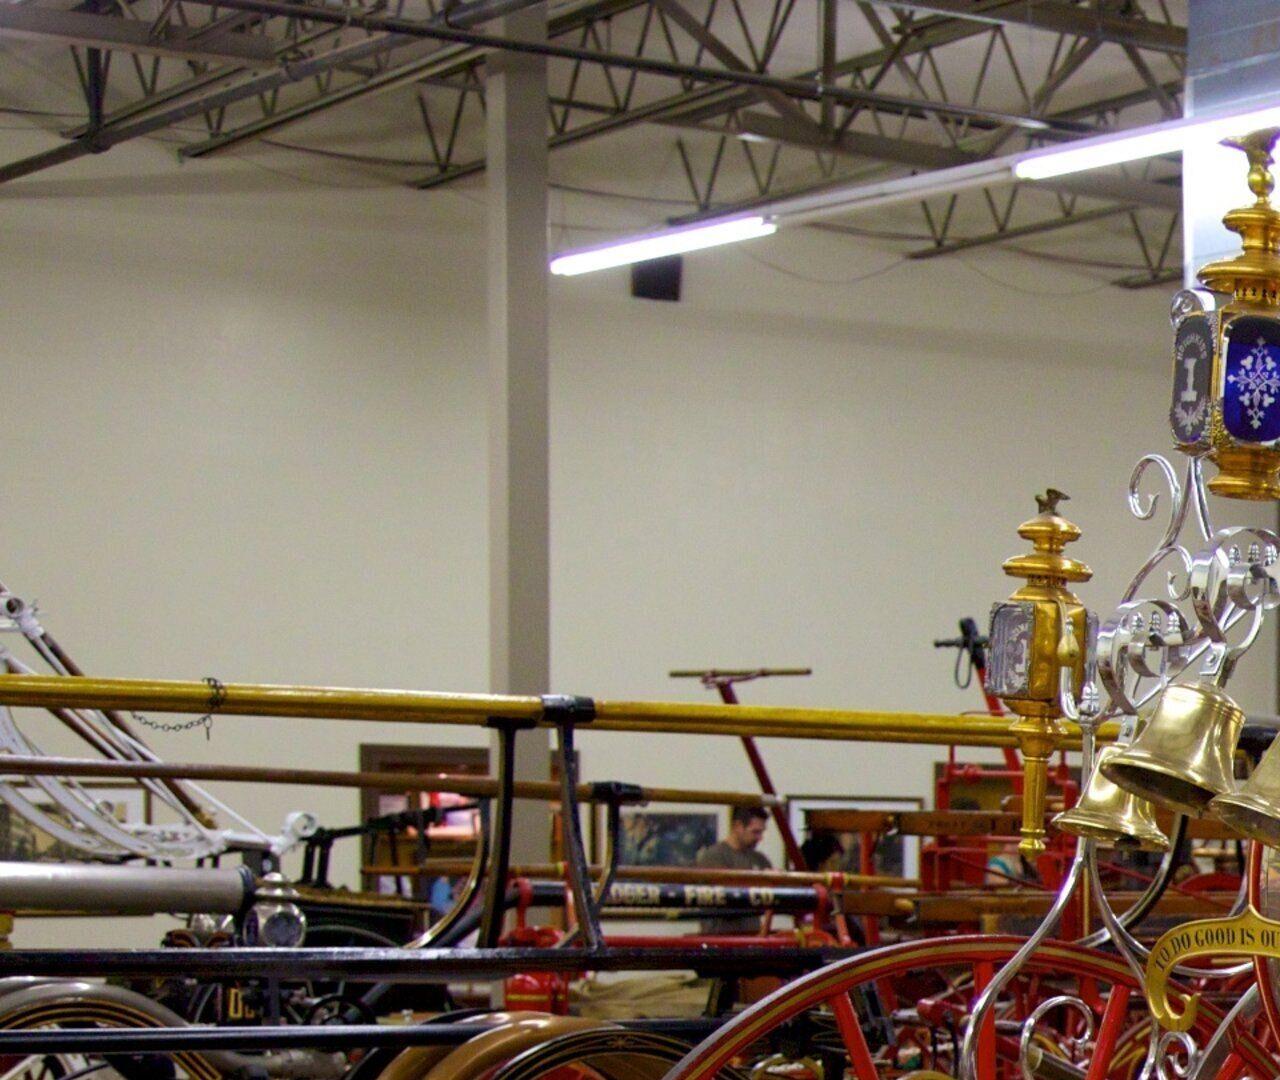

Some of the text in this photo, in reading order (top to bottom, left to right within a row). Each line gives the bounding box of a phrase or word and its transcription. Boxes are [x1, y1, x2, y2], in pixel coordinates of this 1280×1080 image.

[1154, 948, 1172, 972] TO
[1170, 932, 1192, 951] DO
[1194, 927, 1236, 947] GOOD
[1239, 927, 1255, 945] IS
